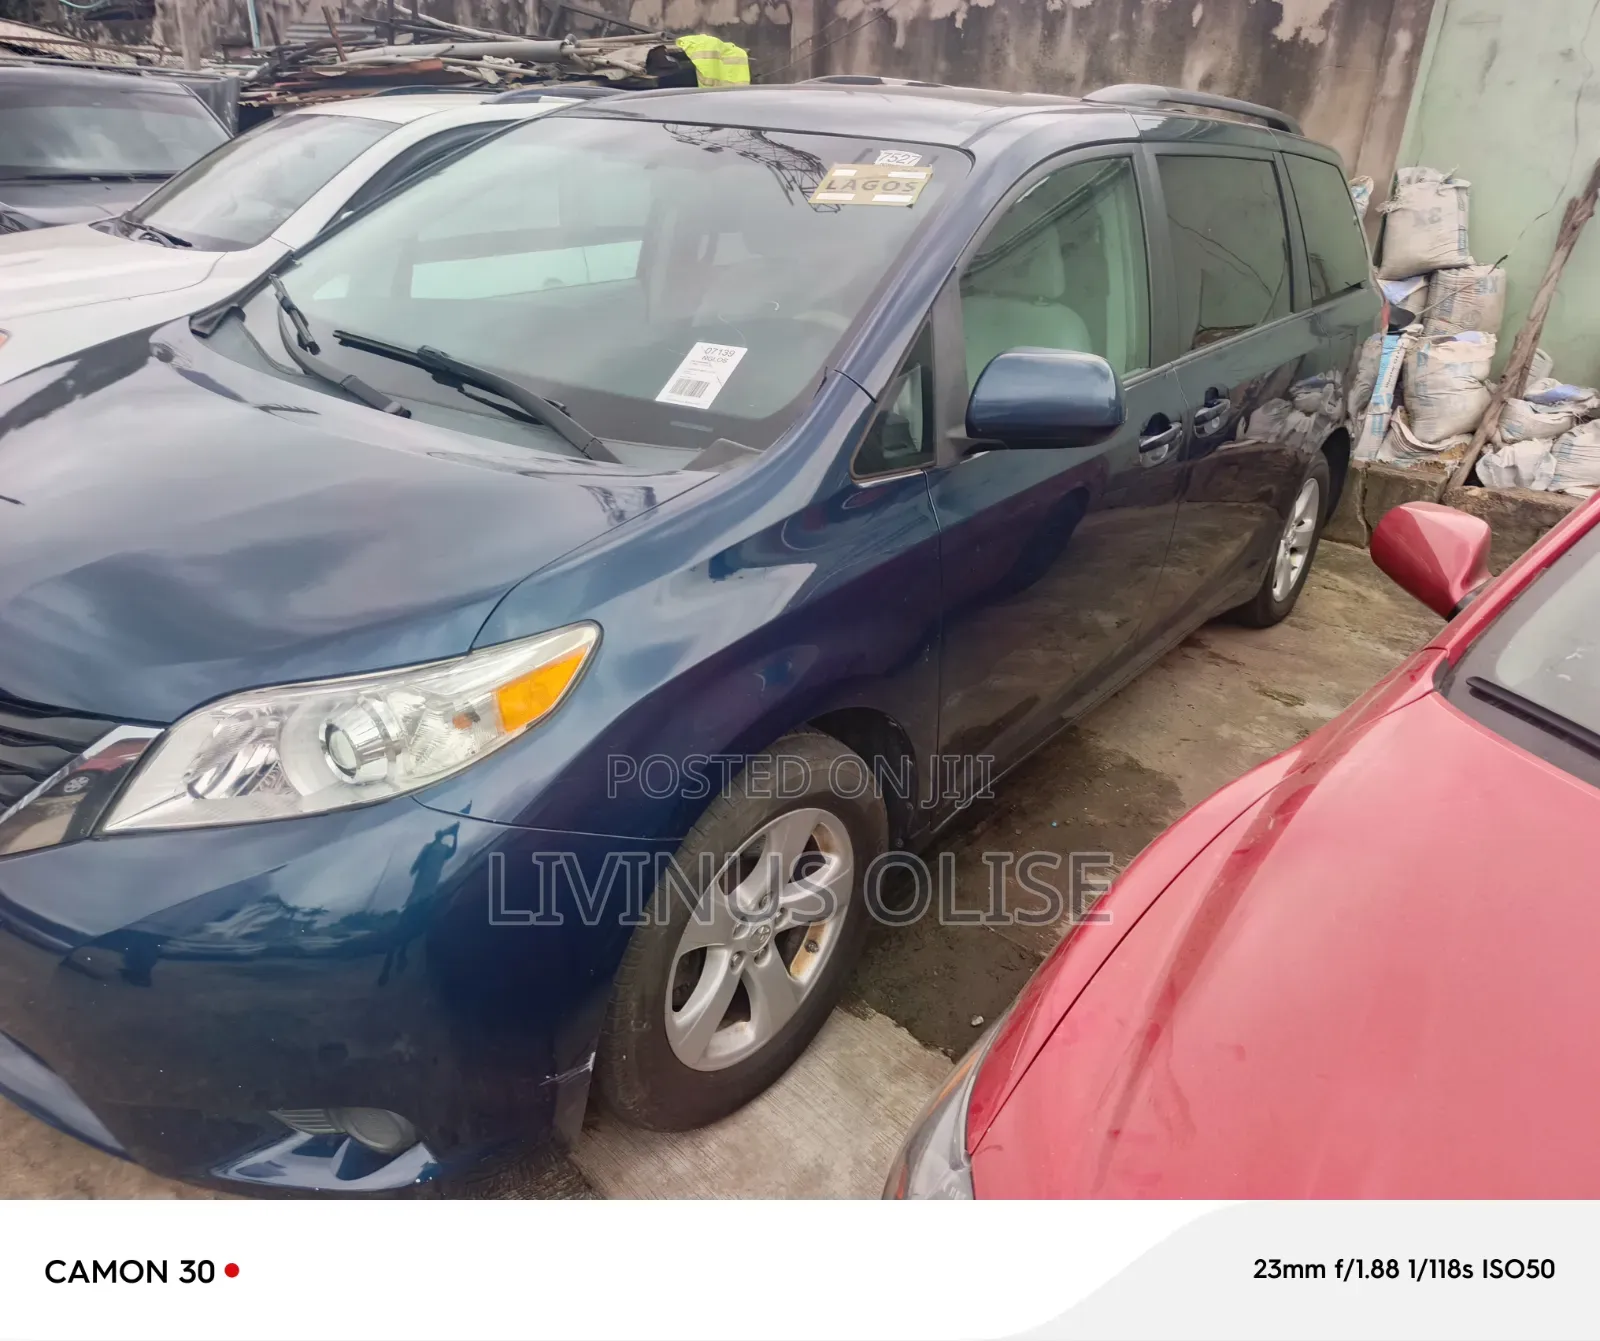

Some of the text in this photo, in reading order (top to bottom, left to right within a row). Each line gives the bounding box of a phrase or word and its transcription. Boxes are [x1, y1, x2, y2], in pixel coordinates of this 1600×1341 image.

[878, 152, 921, 165] 7527
[825, 179, 919, 192] LAGOS
[704, 347, 736, 358] 07139
[701, 355, 729, 364] NGLOS
